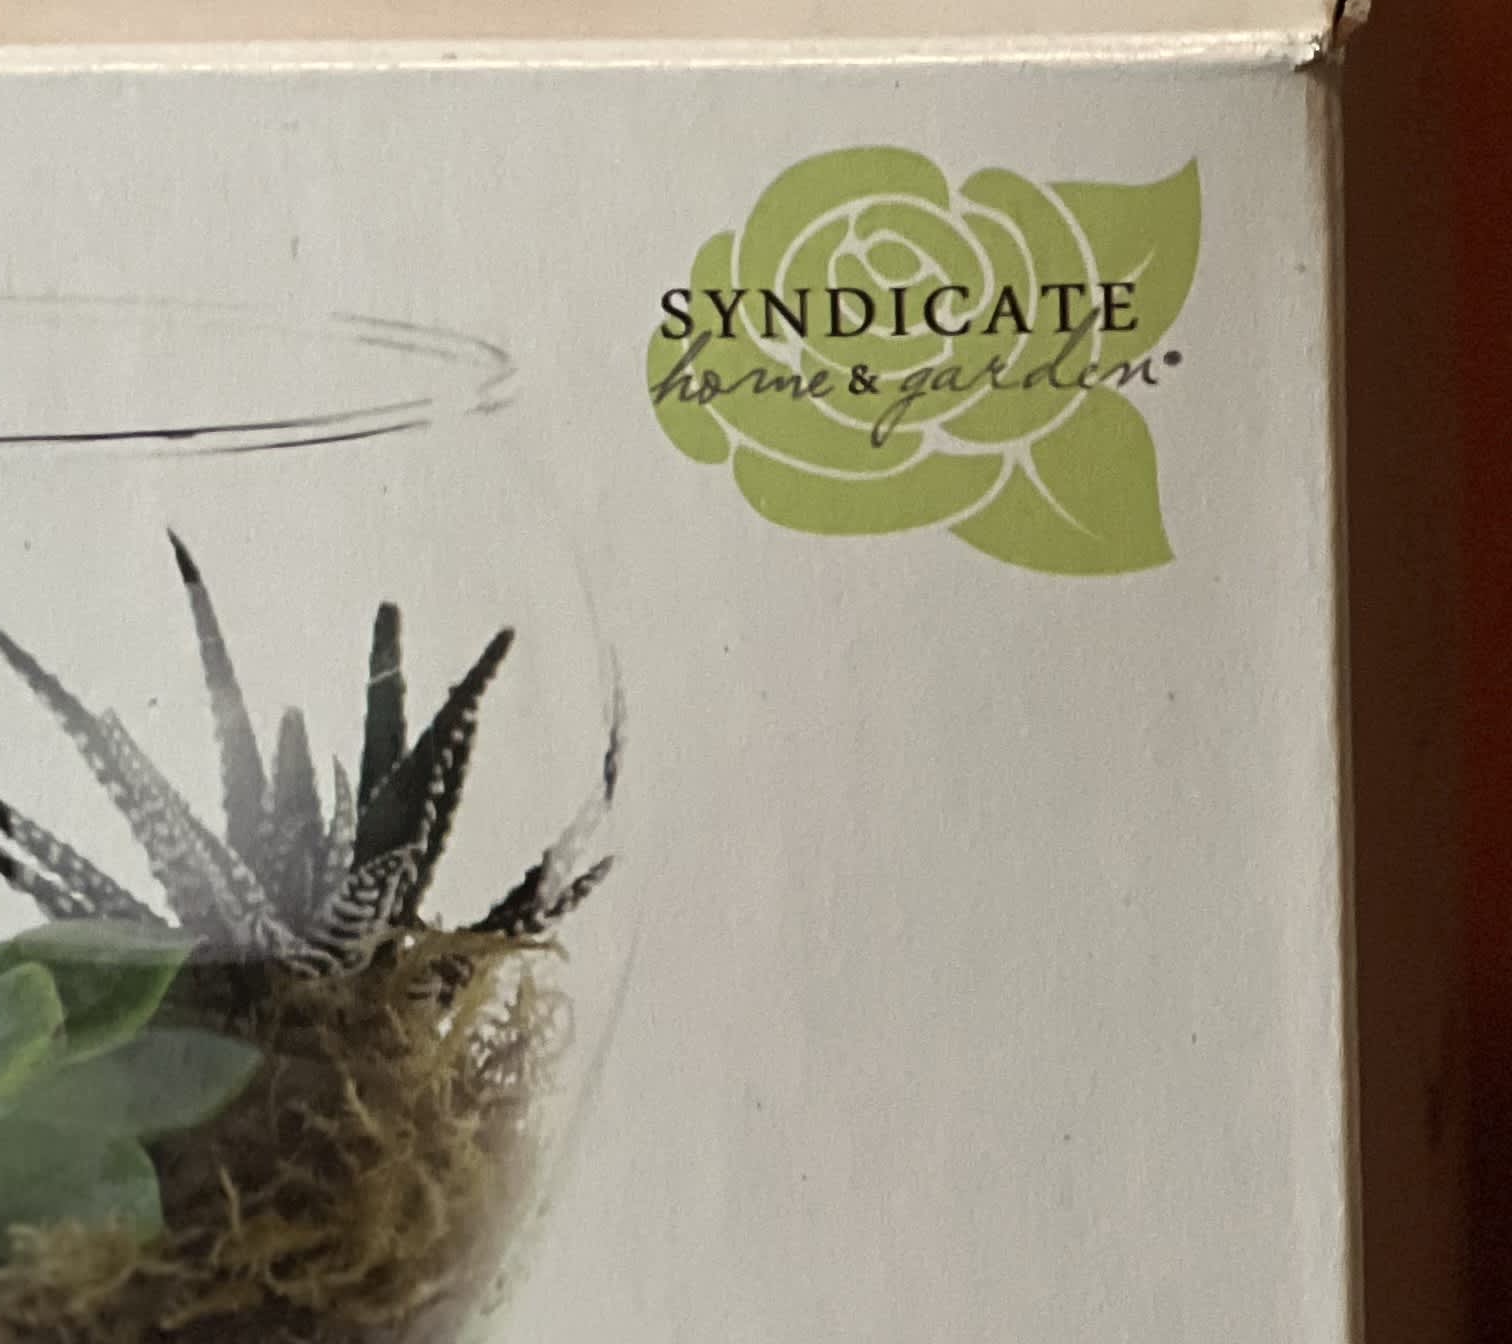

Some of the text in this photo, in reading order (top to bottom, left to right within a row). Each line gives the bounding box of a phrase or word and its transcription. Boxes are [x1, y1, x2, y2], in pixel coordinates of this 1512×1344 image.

[659, 281, 1139, 341] SYNDICATE
[651, 306, 1159, 448] home & garden
